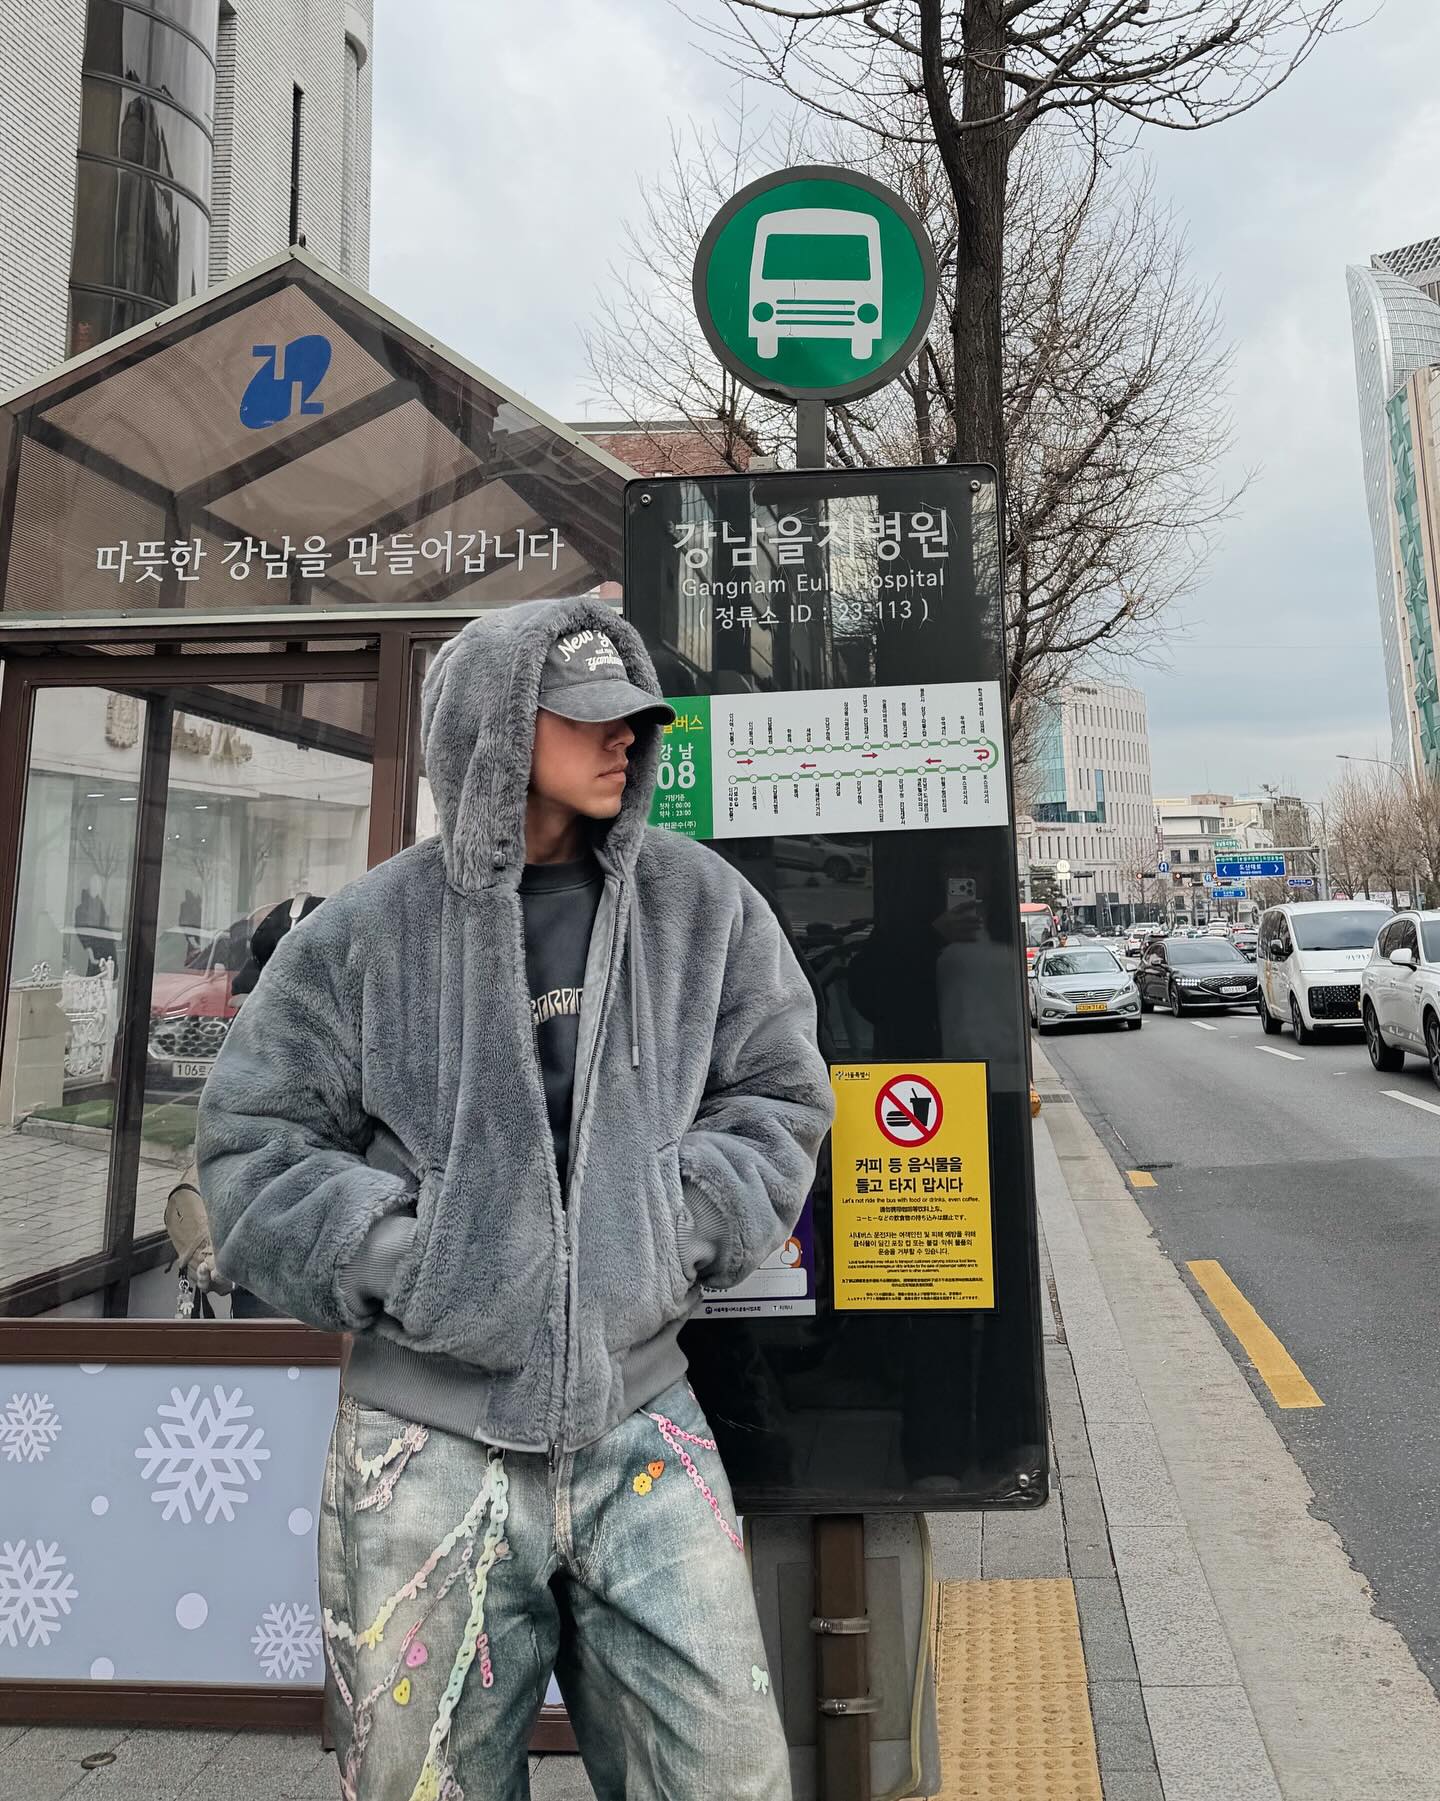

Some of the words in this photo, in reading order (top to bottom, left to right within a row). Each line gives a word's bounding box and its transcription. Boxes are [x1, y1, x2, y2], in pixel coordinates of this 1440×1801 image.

[673, 510, 949, 569] 강남을지병원
[96, 539, 207, 583] 따뜻한
[221, 535, 333, 581] 강남을
[347, 528, 566, 576] 만들어갑니다
[682, 576, 786, 600] Gangnam
[856, 567, 945, 592] Hospital
[715, 606, 780, 630] 정류소
[790, 604, 812, 623] ID
[839, 600, 913, 622] 23-113
[558, 630, 593, 662] New
[656, 760, 696, 789] 08
[856, 1157, 882, 1173] 커피
[888, 1157, 903, 1173] 등
[908, 1156, 963, 1173] 음식물을
[856, 1178, 884, 1194] 들고
[889, 1177, 916, 1193] 타지
[922, 1177, 963, 1193] 맙시다
